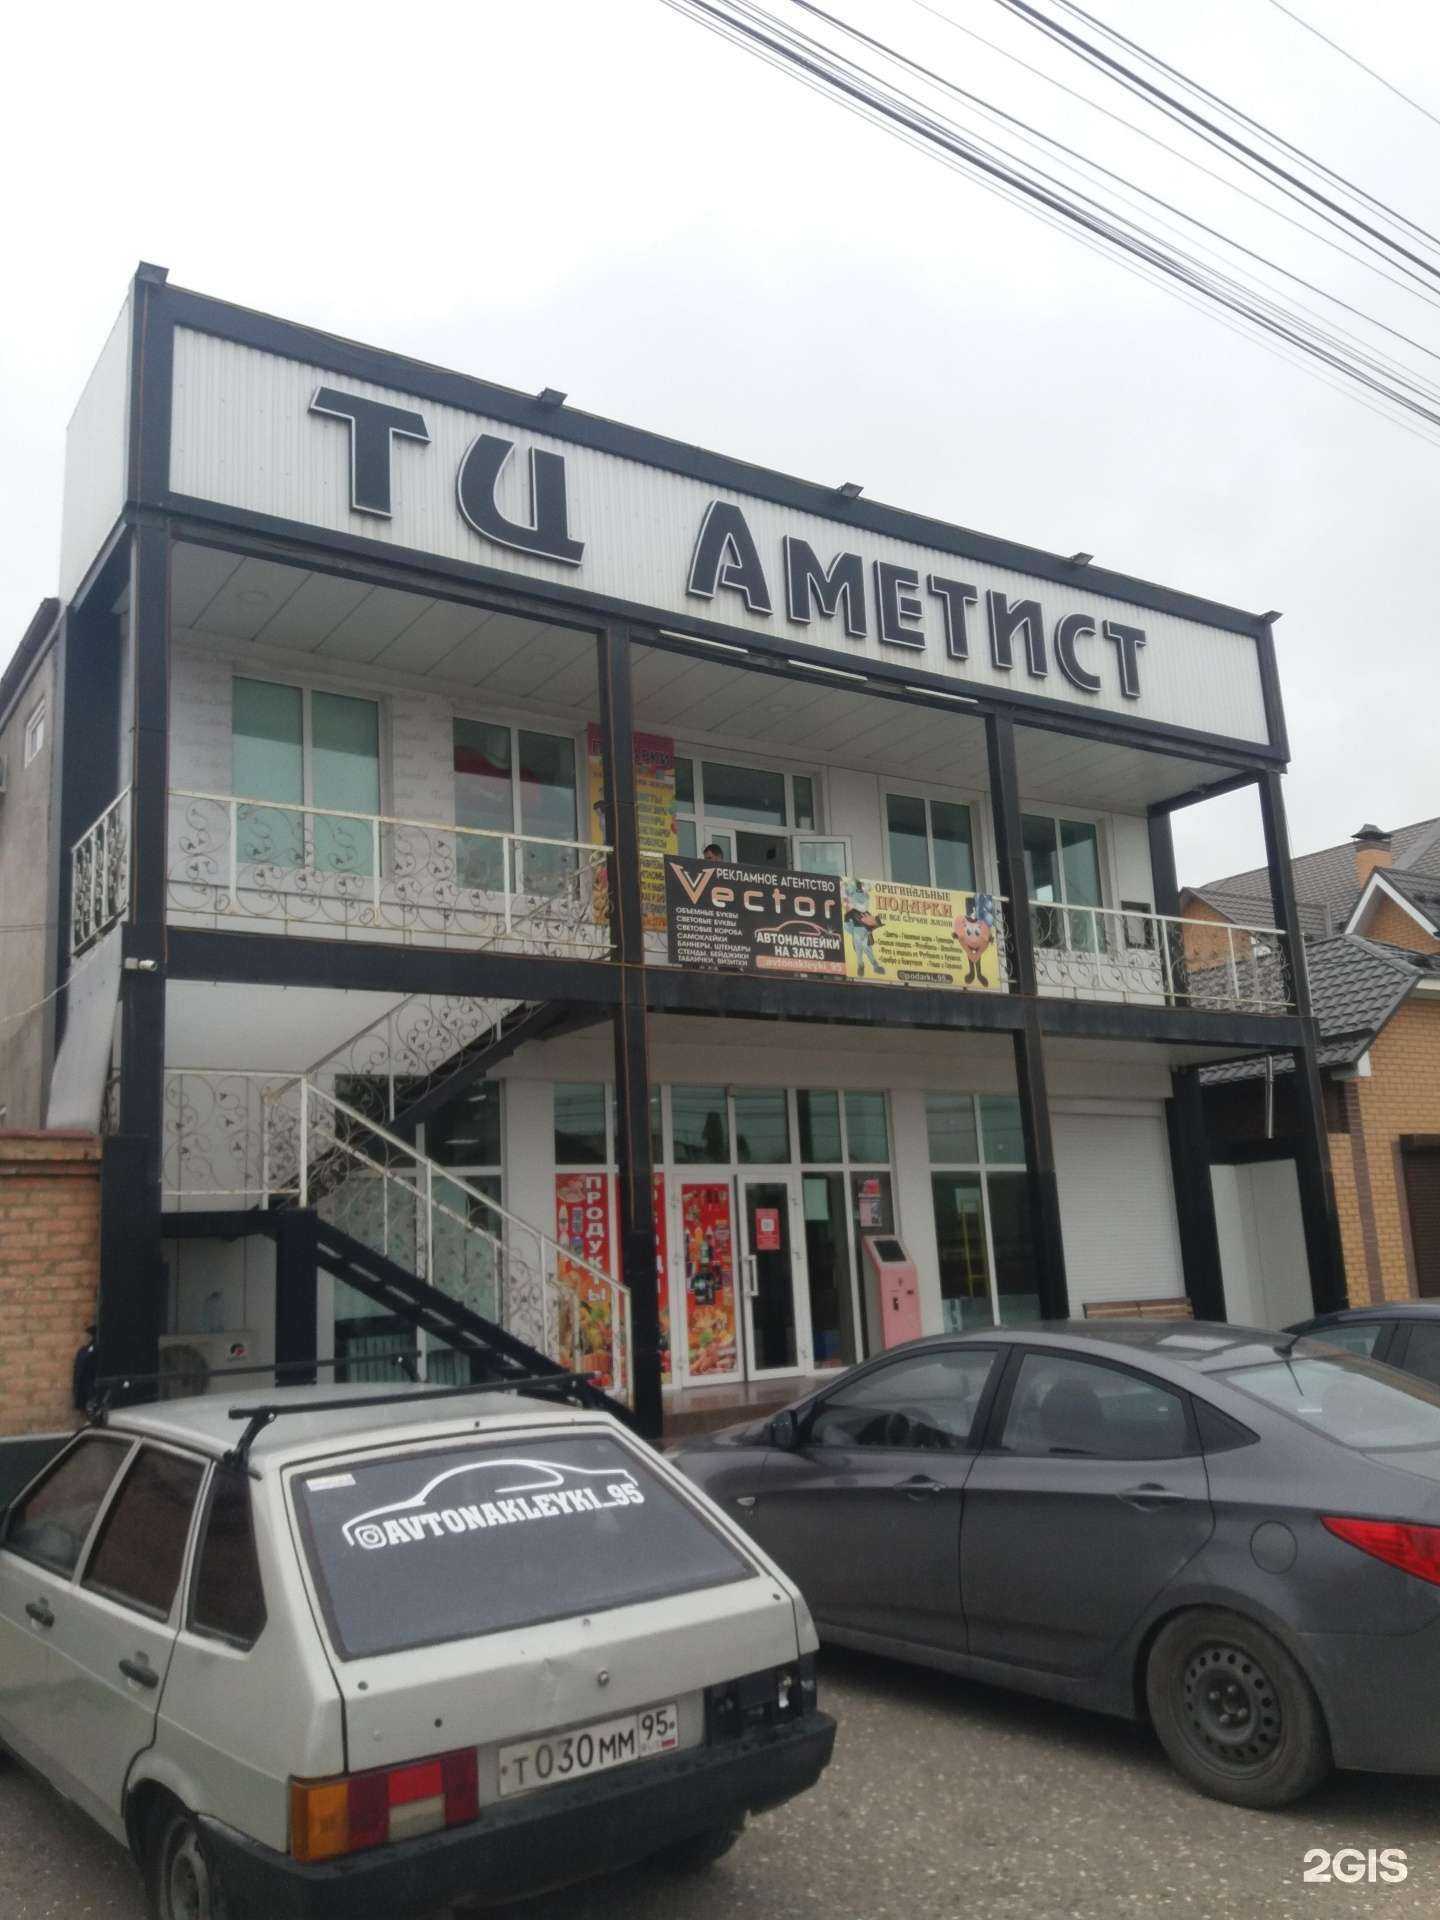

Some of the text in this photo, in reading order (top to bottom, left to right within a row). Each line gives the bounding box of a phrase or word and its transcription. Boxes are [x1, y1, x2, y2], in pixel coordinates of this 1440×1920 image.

[308, 385, 1147, 699] ТЦ АМЕТИСТ
[716, 867, 835, 892] РЕКЛАМНОЕ АГЕНТСТВО
[669, 862, 836, 919] Vector
[875, 883, 951, 901] ОРИГИНАЛЬНЫЕ
[716, 911, 738, 919] БУКВЫ
[876, 896, 953, 917] ПОДАРКИ
[676, 915, 712, 925] СВЕТОВЫЕ
[757, 932, 840, 950] АВТОНАКЛЕЙКИ
[774, 946, 825, 960] НА ЗАКАЗ
